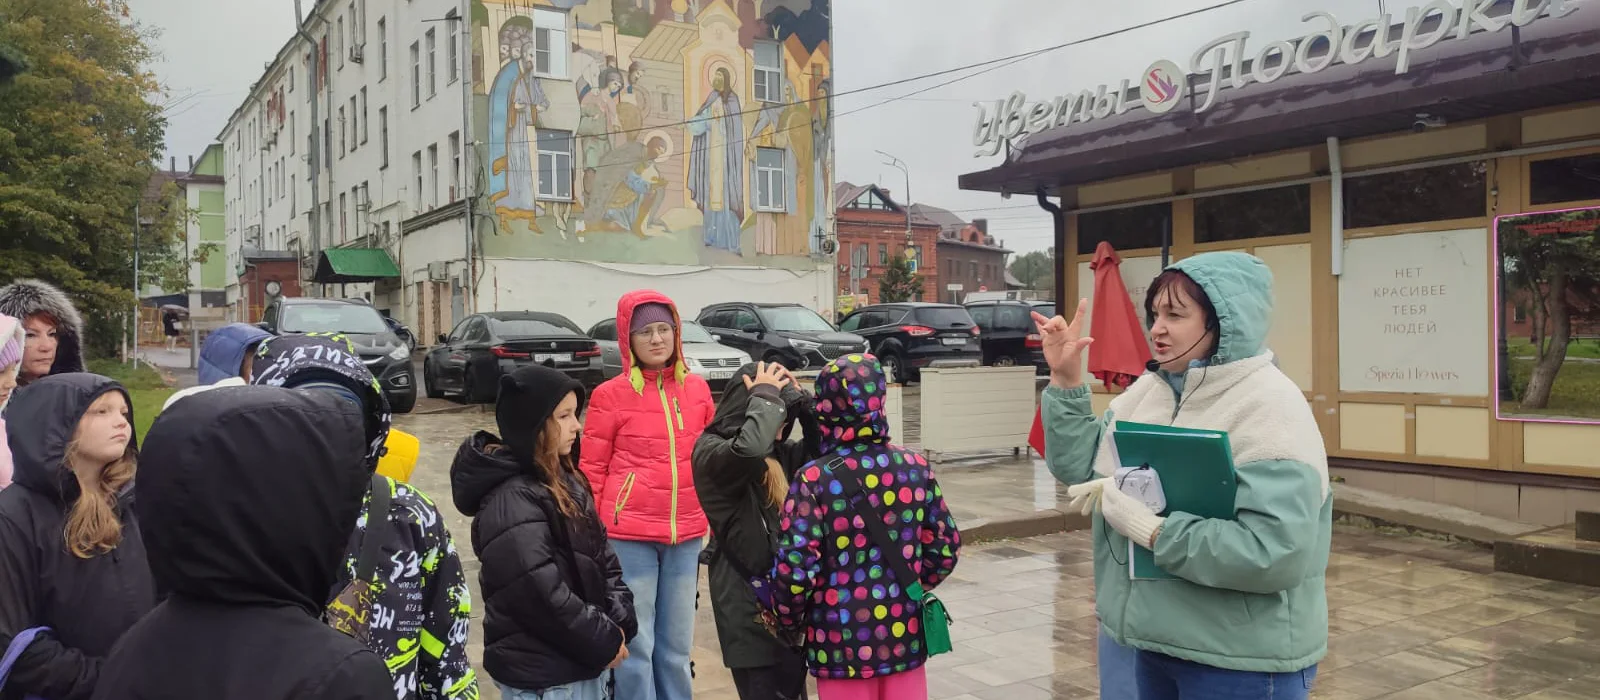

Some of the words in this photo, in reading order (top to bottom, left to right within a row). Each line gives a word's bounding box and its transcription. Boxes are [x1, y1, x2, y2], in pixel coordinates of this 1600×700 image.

[972, 78, 1131, 158] Цветы
[1395, 267, 1423, 279] НЕТ
[1373, 284, 1447, 298] КРАСИВЕЕ
[1392, 304, 1427, 316] ТЕБЯ
[1383, 321, 1437, 335] ЛЮДЕЙ
[390, 549, 422, 583] ES
